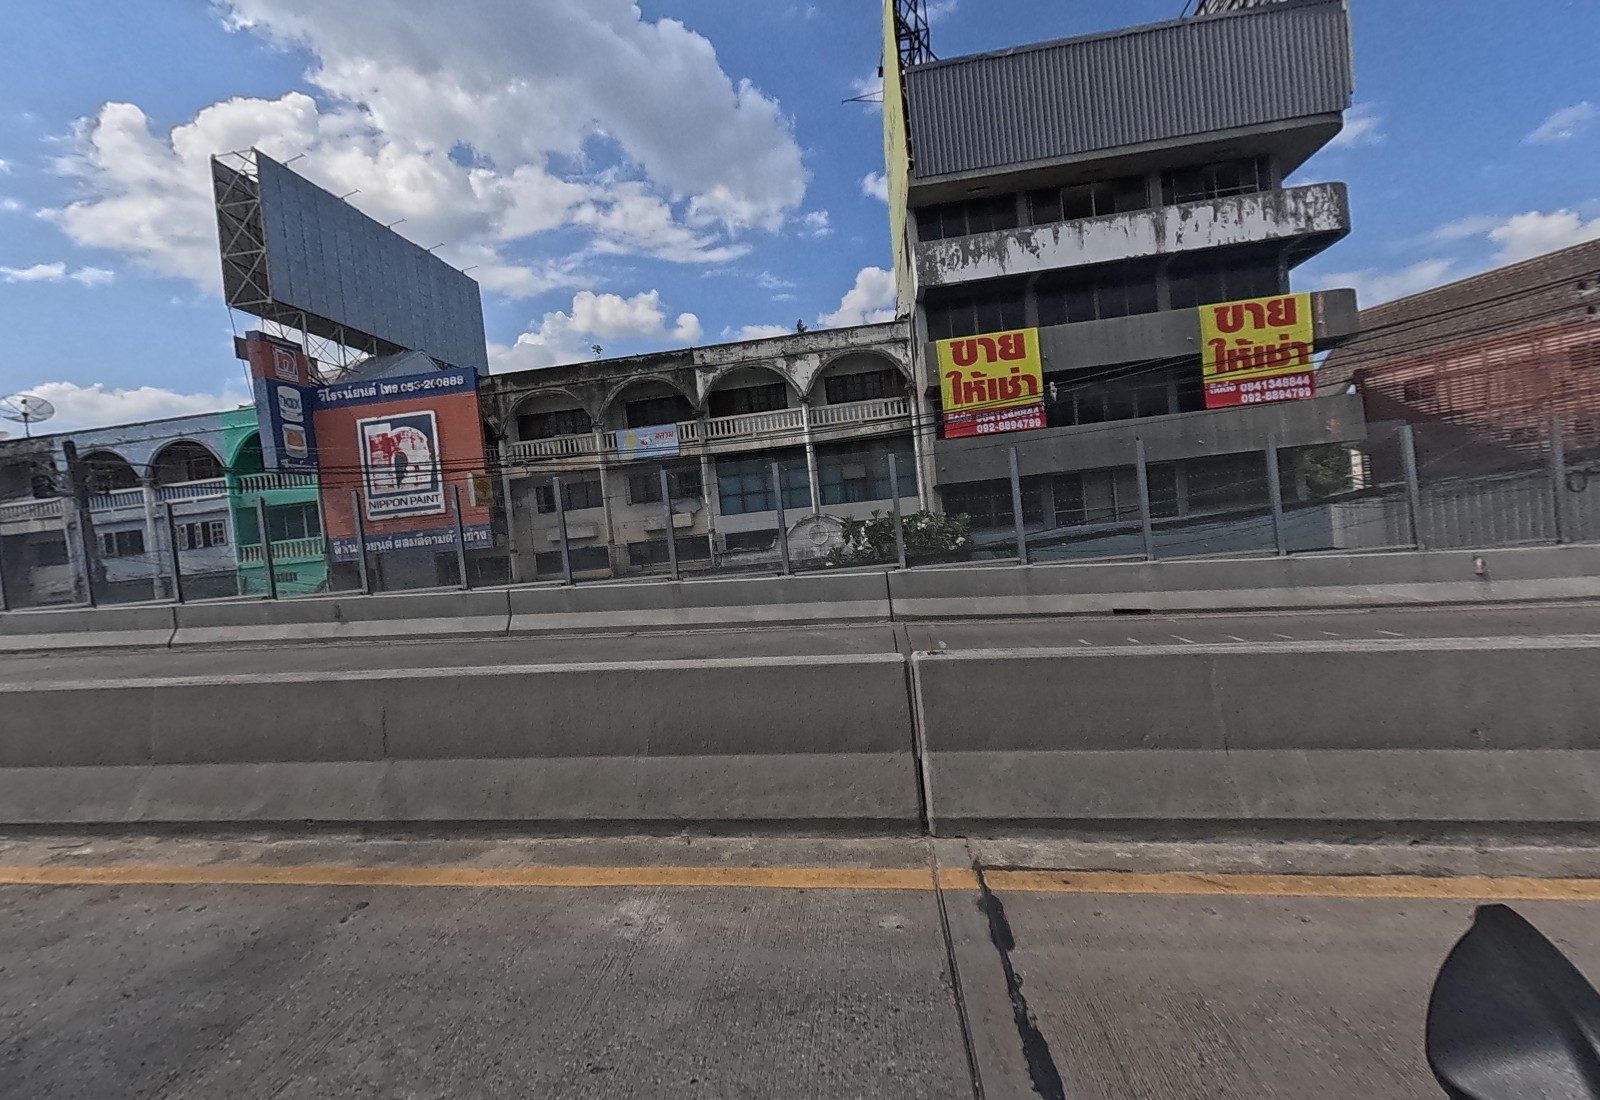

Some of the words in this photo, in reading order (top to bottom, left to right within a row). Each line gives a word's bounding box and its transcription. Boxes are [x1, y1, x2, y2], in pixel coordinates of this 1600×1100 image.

[1214, 298, 1297, 333] ขาย
[950, 332, 1027, 367] ขาย
[1207, 333, 1309, 374] ให้เช่า
[945, 366, 1038, 405] ให้เช่า
[368, 497, 408, 510] NIPPON
[410, 494, 441, 506] PAINT
